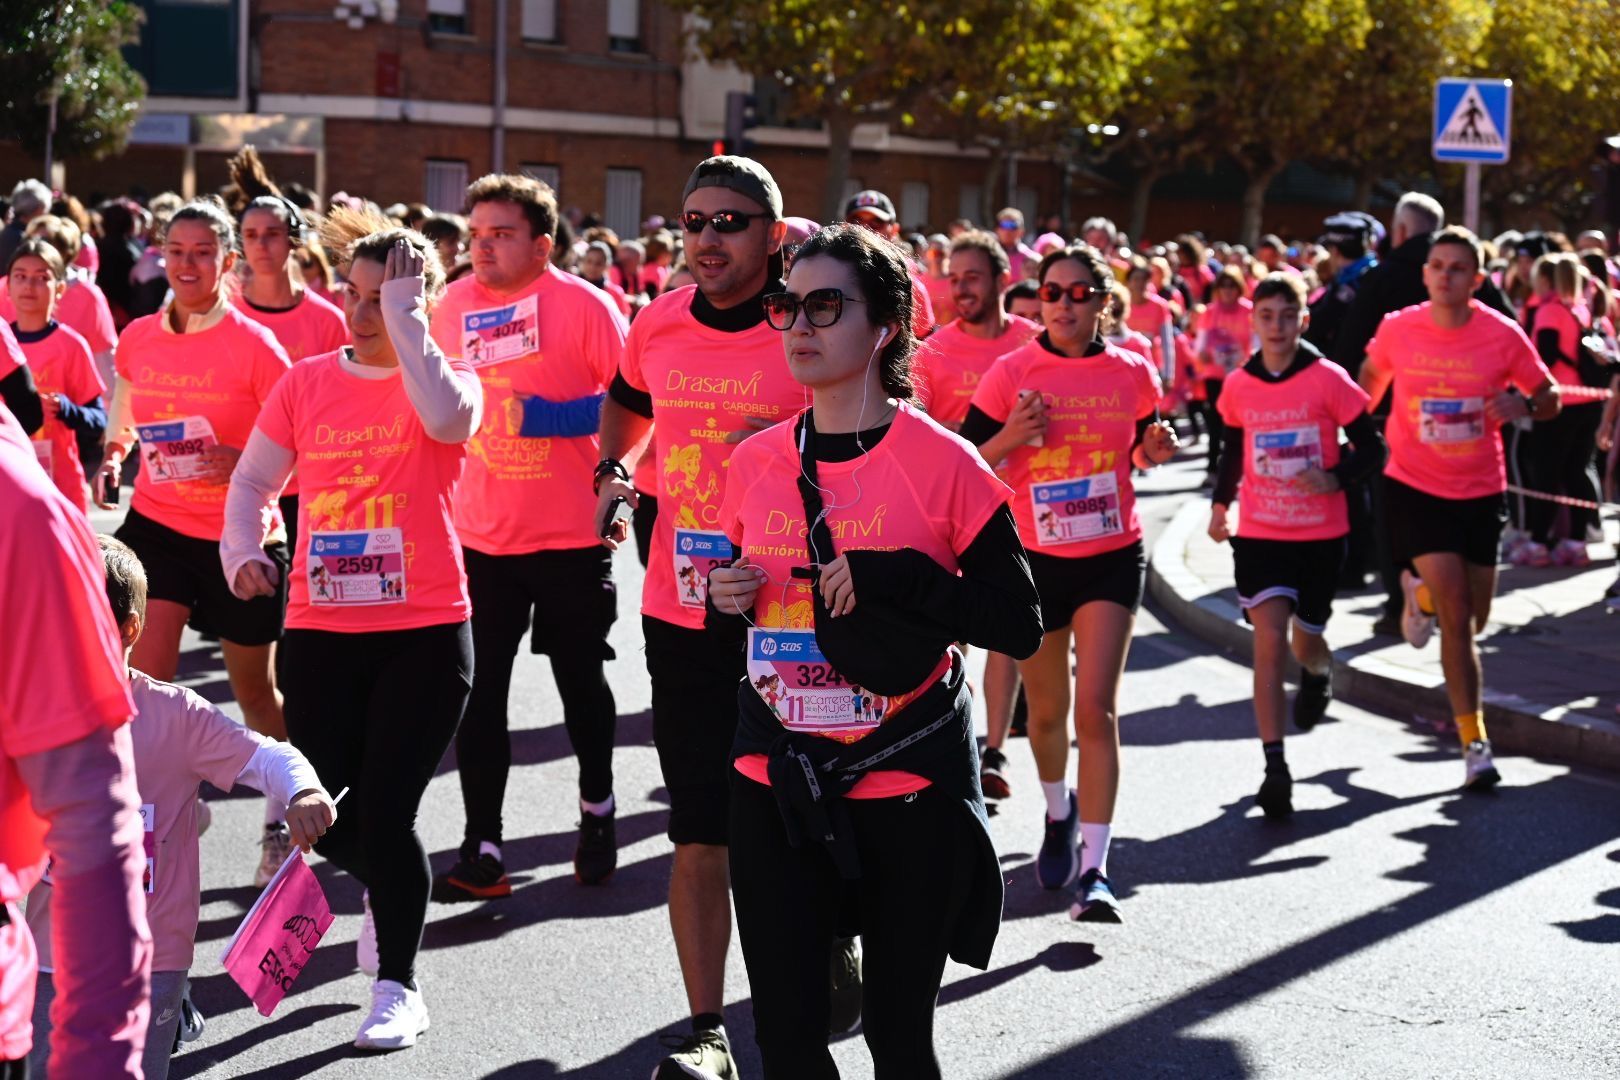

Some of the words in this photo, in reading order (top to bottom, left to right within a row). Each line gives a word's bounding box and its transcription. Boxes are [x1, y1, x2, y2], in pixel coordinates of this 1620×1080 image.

[492, 319, 526, 338] 4072
[666, 369, 763, 397] Drasanví
[722, 400, 780, 415] CAROBELS
[315, 414, 405, 445] Drasanví
[690, 429, 731, 439] SUZUK
[167, 438, 206, 456] 0992
[338, 475, 380, 485] SUZUKI
[1065, 496, 1109, 516] 0985
[765, 504, 887, 539] Draanví
[682, 537, 693, 551] hp
[695, 541, 713, 550] SCDS
[747, 544, 810, 559] MULTIÓPTI
[337, 555, 384, 574] 2597
[762, 637, 777, 656] hp
[779, 642, 803, 651] SCDS
[796, 664, 857, 688] 324
[810, 694, 852, 705] Carrera
[817, 703, 852, 715] Mujer
